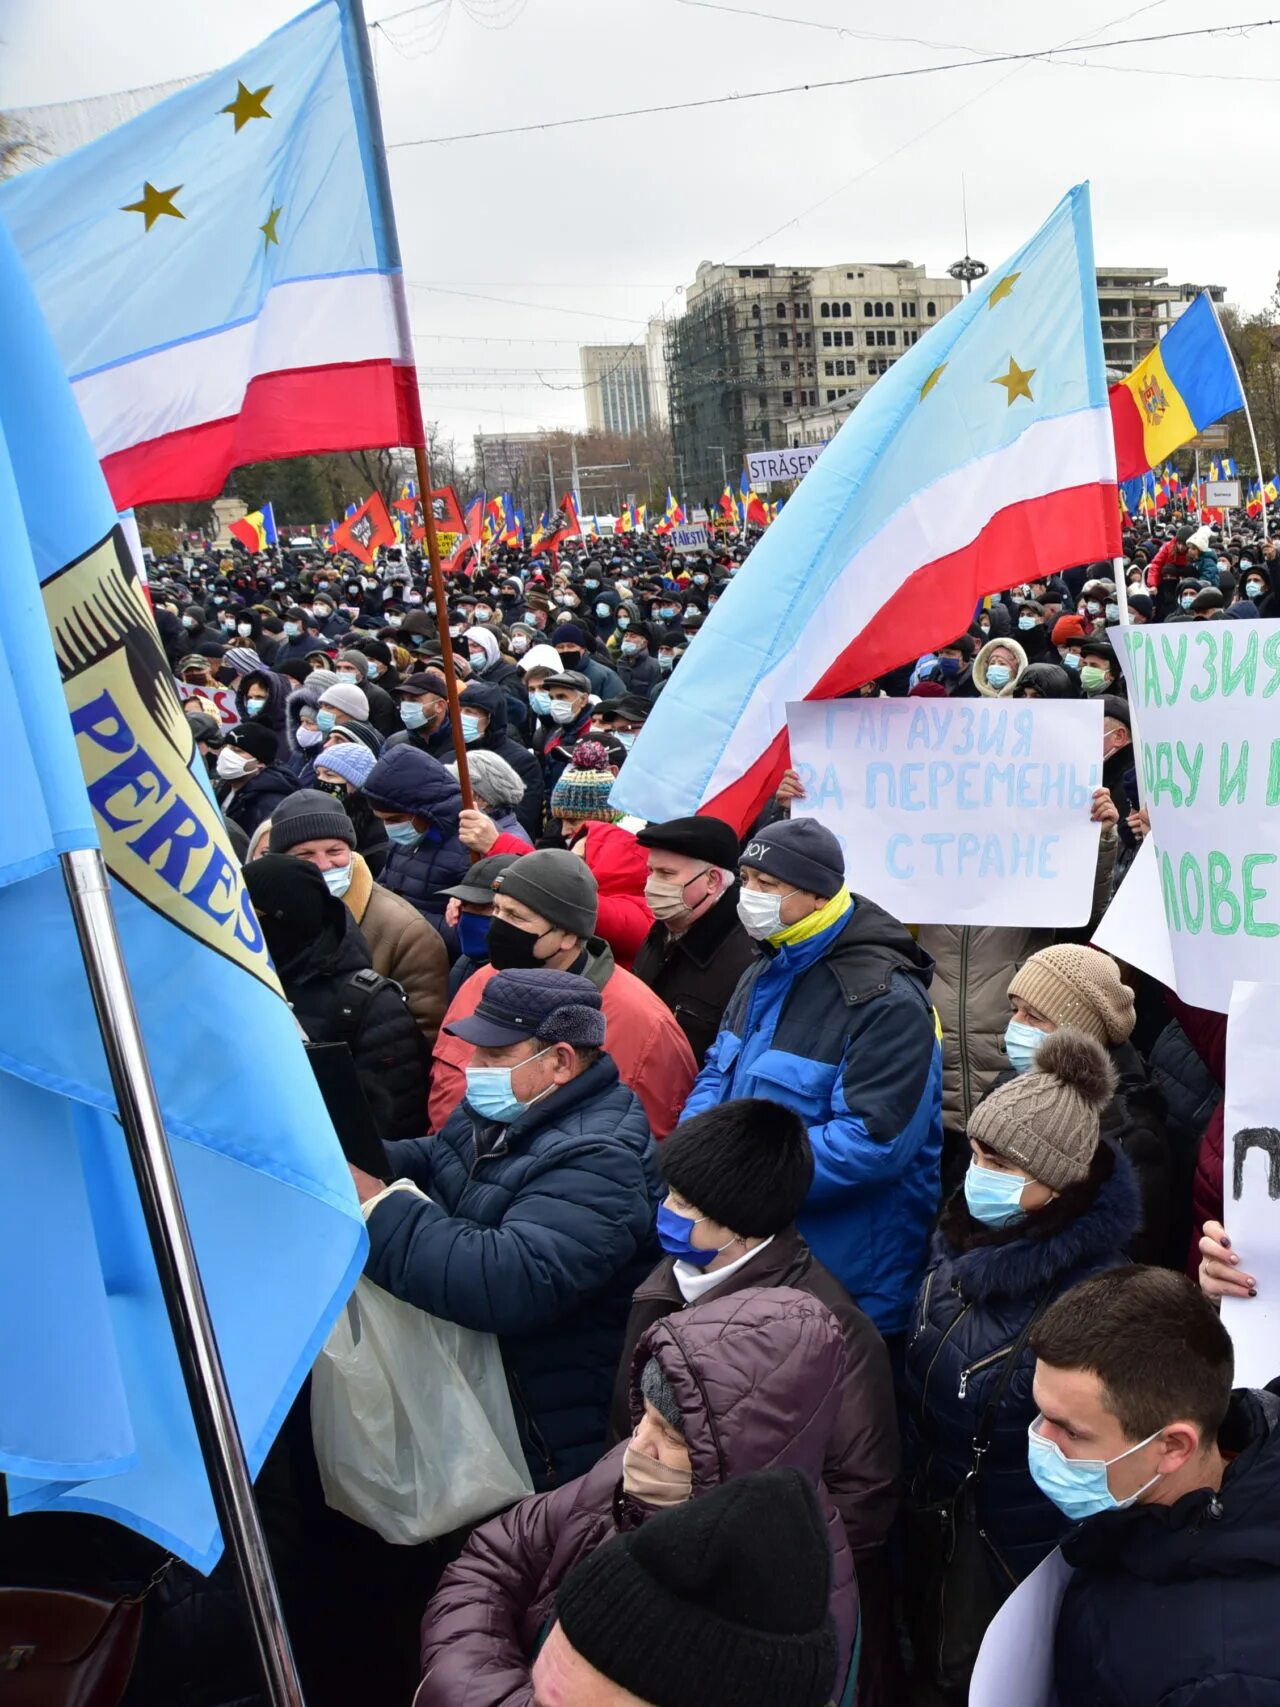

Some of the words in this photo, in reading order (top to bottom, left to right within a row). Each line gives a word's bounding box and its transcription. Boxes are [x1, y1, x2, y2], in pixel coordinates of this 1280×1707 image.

[825, 703, 1034, 757] ГАГАУЗИЯ
[796, 761, 846, 811] ЗА
[865, 760, 1098, 812] ПЕРЕМЕНЫ
[1219, 739, 1249, 807] И
[884, 831, 1061, 881] СТРАНЕ
